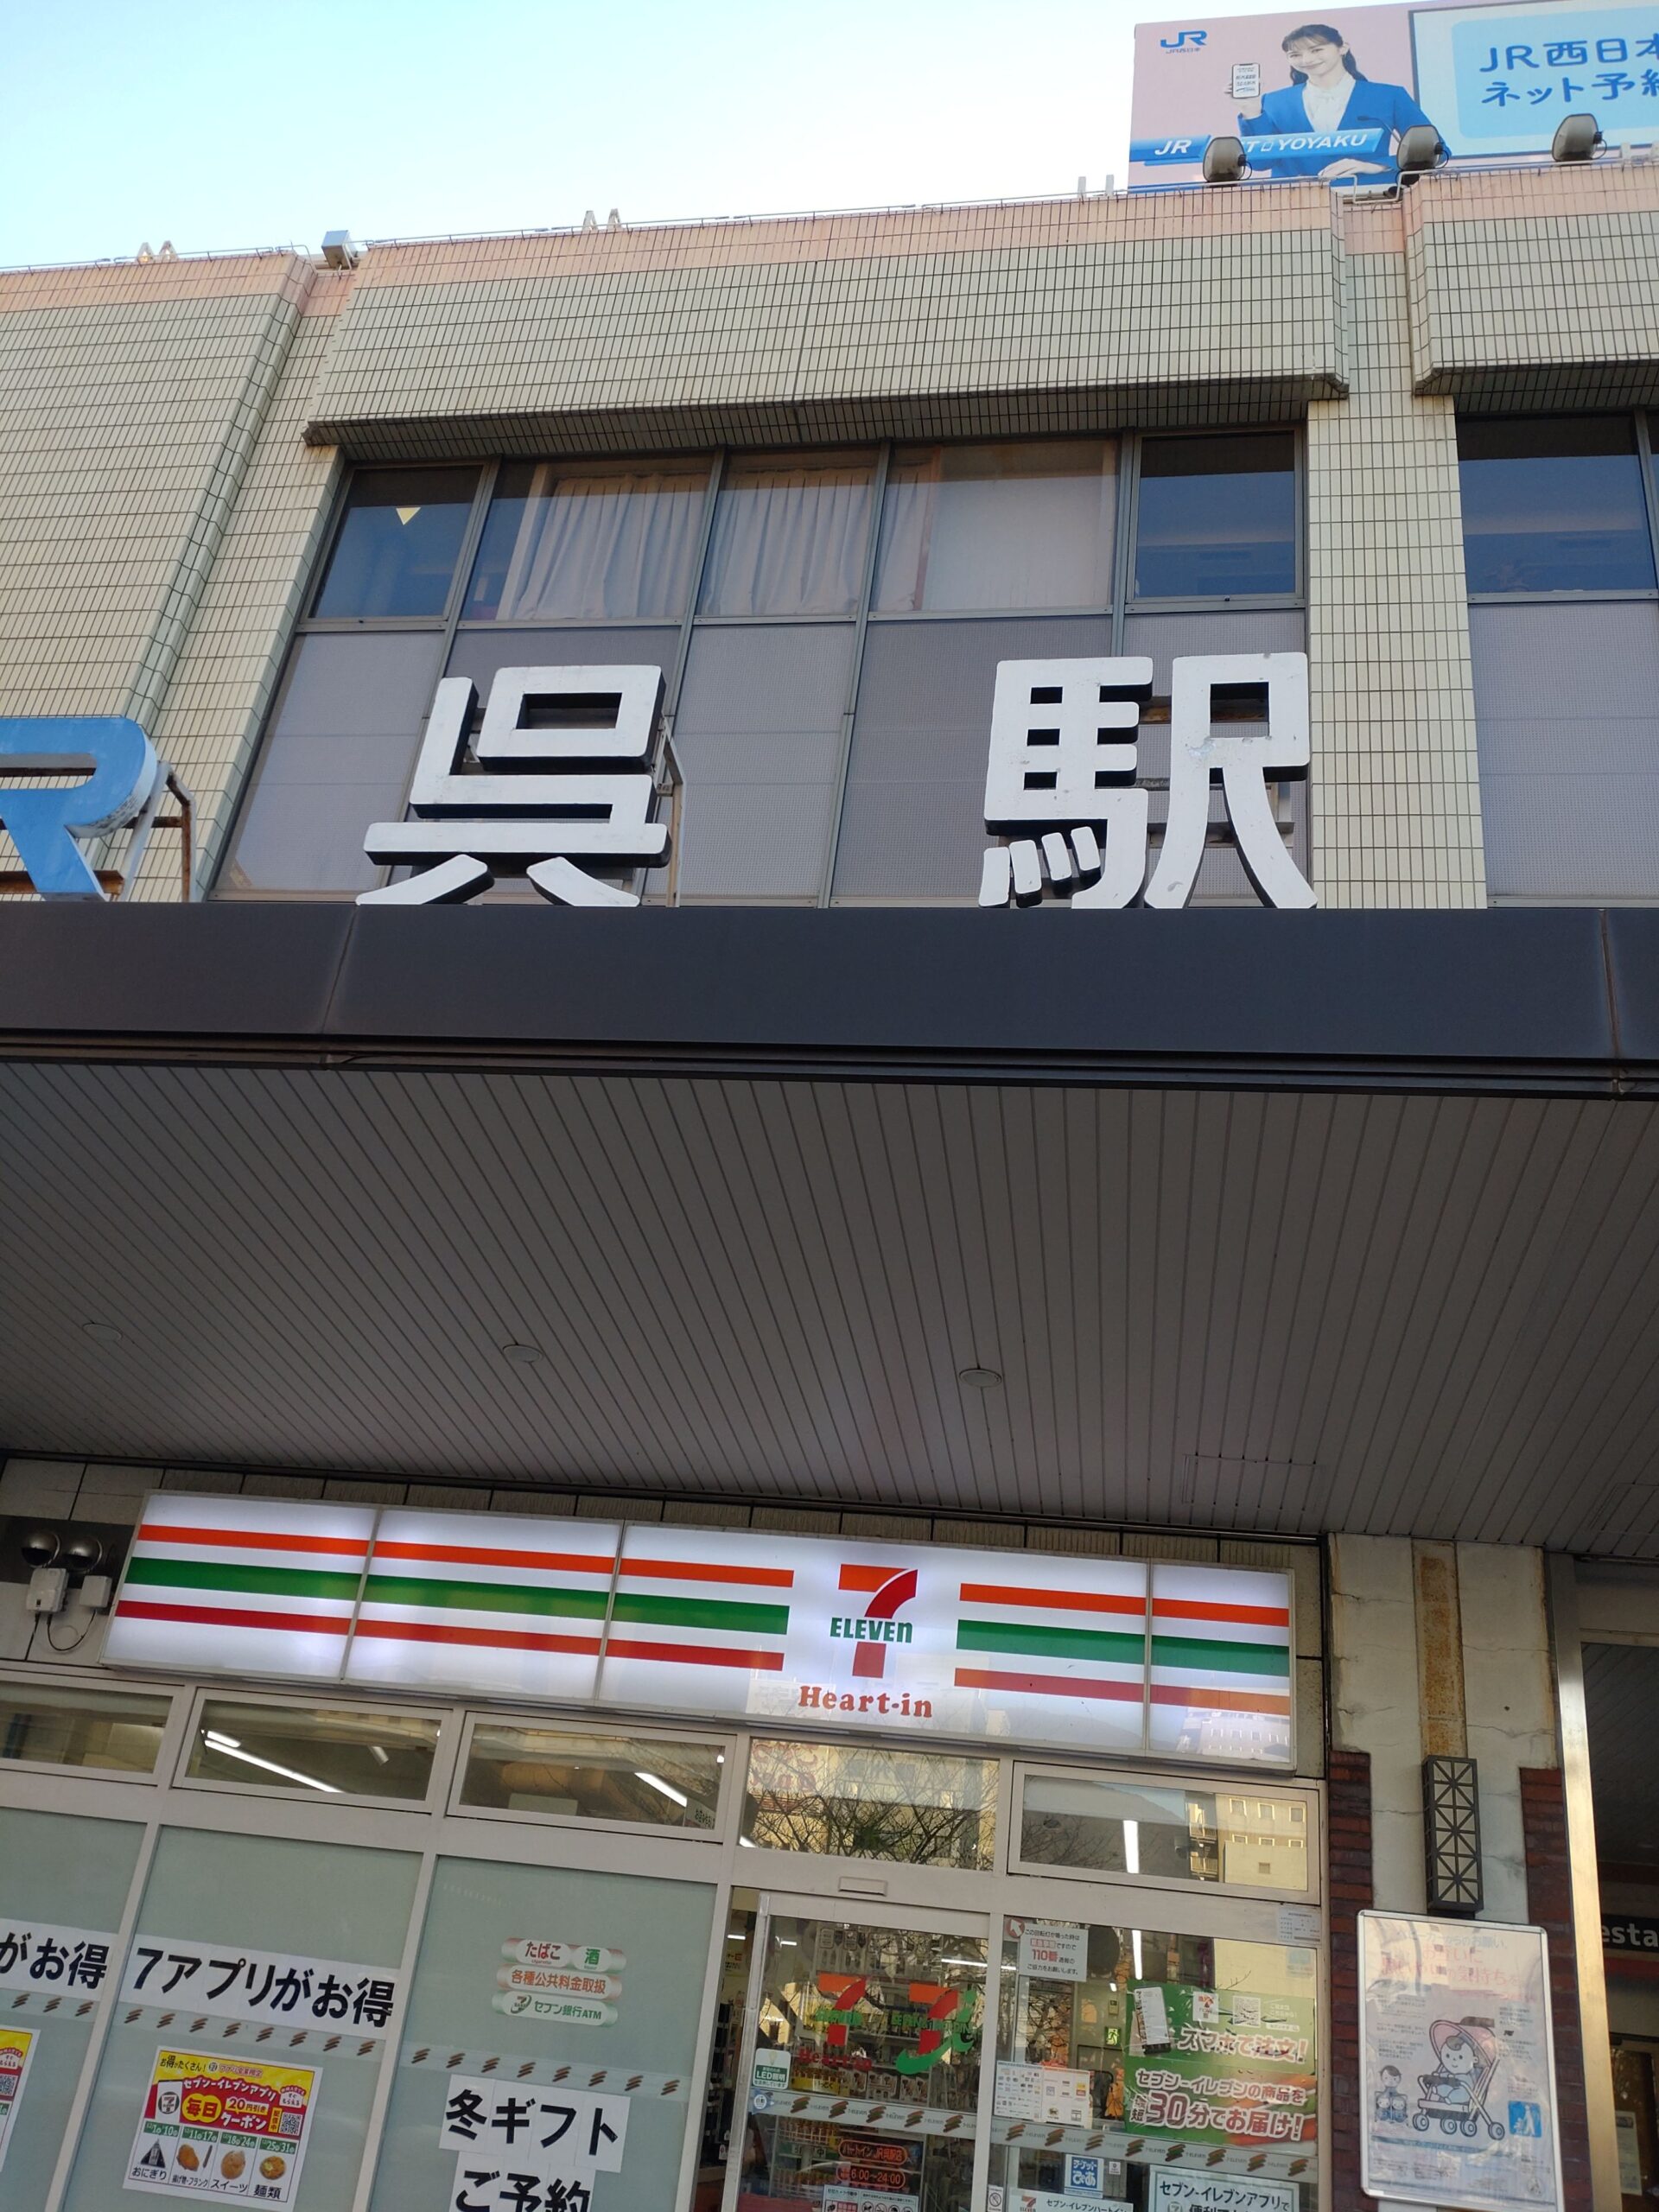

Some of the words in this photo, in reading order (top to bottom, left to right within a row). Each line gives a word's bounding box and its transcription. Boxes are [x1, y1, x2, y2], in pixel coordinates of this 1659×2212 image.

[1160, 30, 1207, 48] JR
[1154, 139, 1192, 156] JR
[1277, 134, 1368, 152] YOYAKU
[838, 1563, 918, 1678] 7
[798, 1685, 932, 1718] Heart-in
[0, 1932, 110, 1989] がお得
[525, 1941, 562, 1960] たばこ
[584, 1948, 601, 1966] 酒
[133, 1947, 395, 2028] 7アプリがお得
[512, 1969, 607, 1994] 各種公共料金取扱
[534, 2000, 602, 2019] セブン銀行ATM
[1179, 2027, 1308, 2063] スマホで注文！
[186, 2097, 218, 2117] 毎日
[228, 2097, 267, 2113] 20円引き
[221, 2112, 267, 2130] クーポン
[446, 2089, 619, 2155] 冬ギフト
[132, 2166, 167, 2180] おにぎり
[211, 2178, 249, 2193] スイーツ
[254, 2184, 282, 2199] 麺類
[455, 2171, 591, 2212] ご予約
